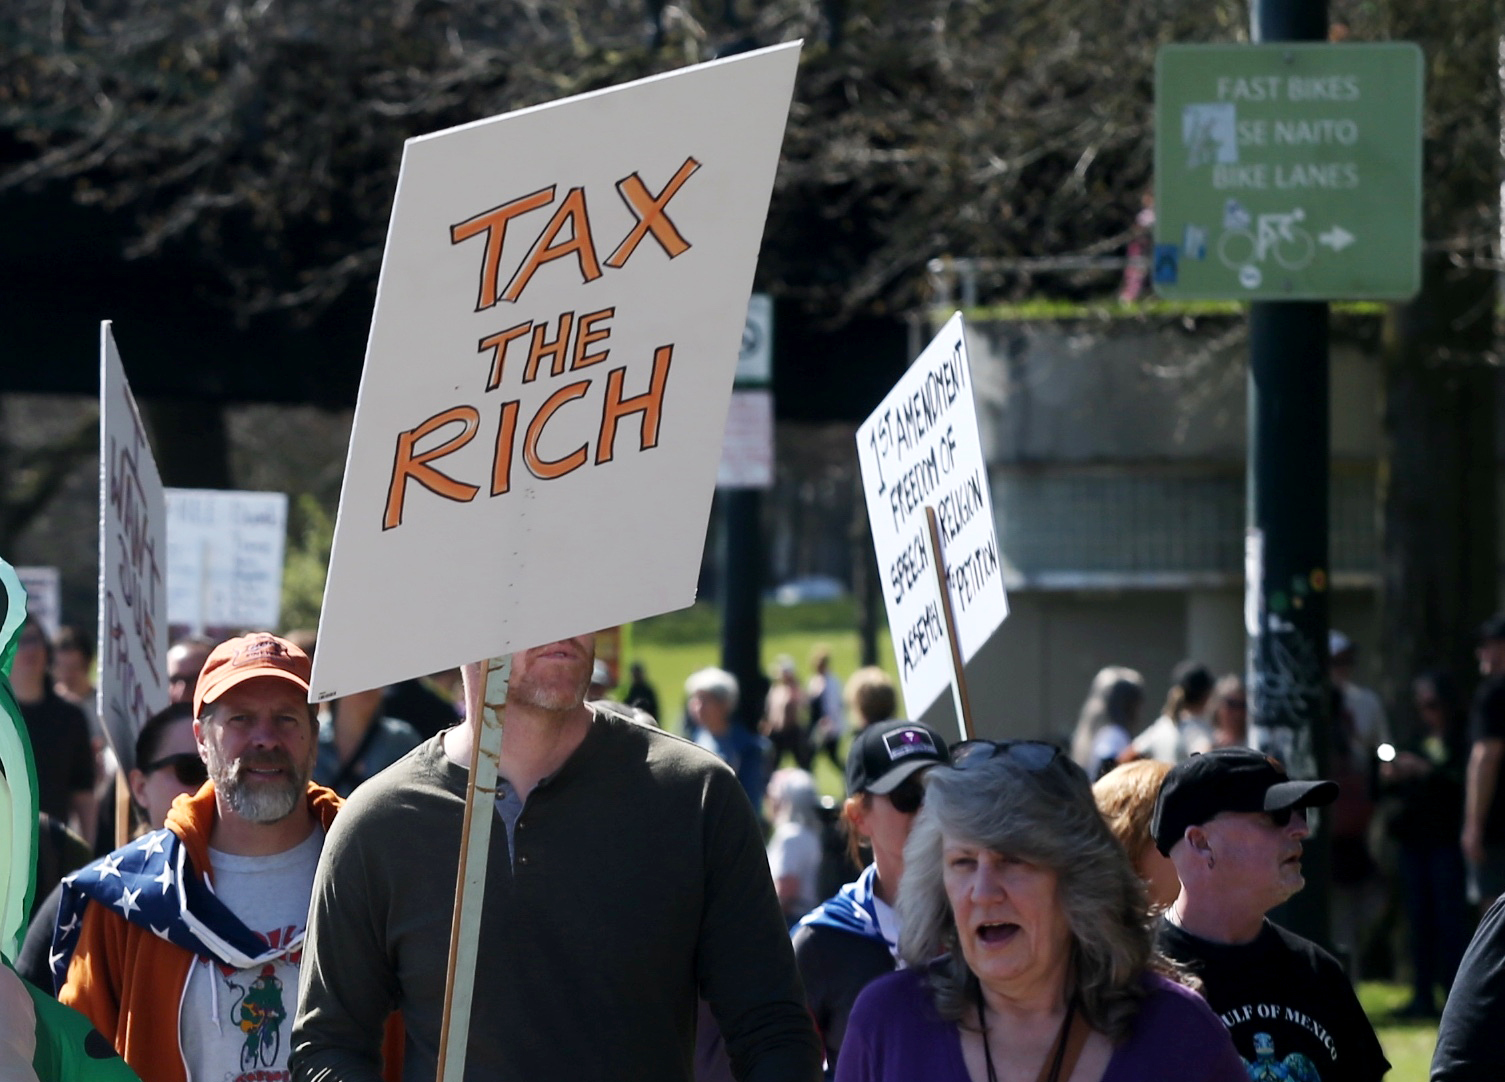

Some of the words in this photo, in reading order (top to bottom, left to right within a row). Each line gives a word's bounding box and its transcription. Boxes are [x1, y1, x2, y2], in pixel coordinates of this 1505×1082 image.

[1217, 76, 1280, 100] FAST
[1287, 75, 1360, 100] BIKES
[1238, 120, 1267, 145] SE
[1274, 119, 1359, 146] NAITO
[1212, 164, 1267, 190] BIKE
[1274, 163, 1360, 190] LANES
[449, 155, 702, 313] TAX
[477, 306, 616, 393] THE
[382, 343, 675, 532] RICH
[896, 339, 966, 462] AMENDMENT
[890, 446, 940, 534] FREEDOM
[939, 425, 956, 475] OF
[890, 526, 929, 605] SPEECH
[937, 467, 984, 549] RELIGION
[954, 529, 998, 613] PETITION
[1221, 1004, 1253, 1028] ULF
[1257, 1003, 1280, 1019] OF
[1285, 1006, 1337, 1061] MEXICO
